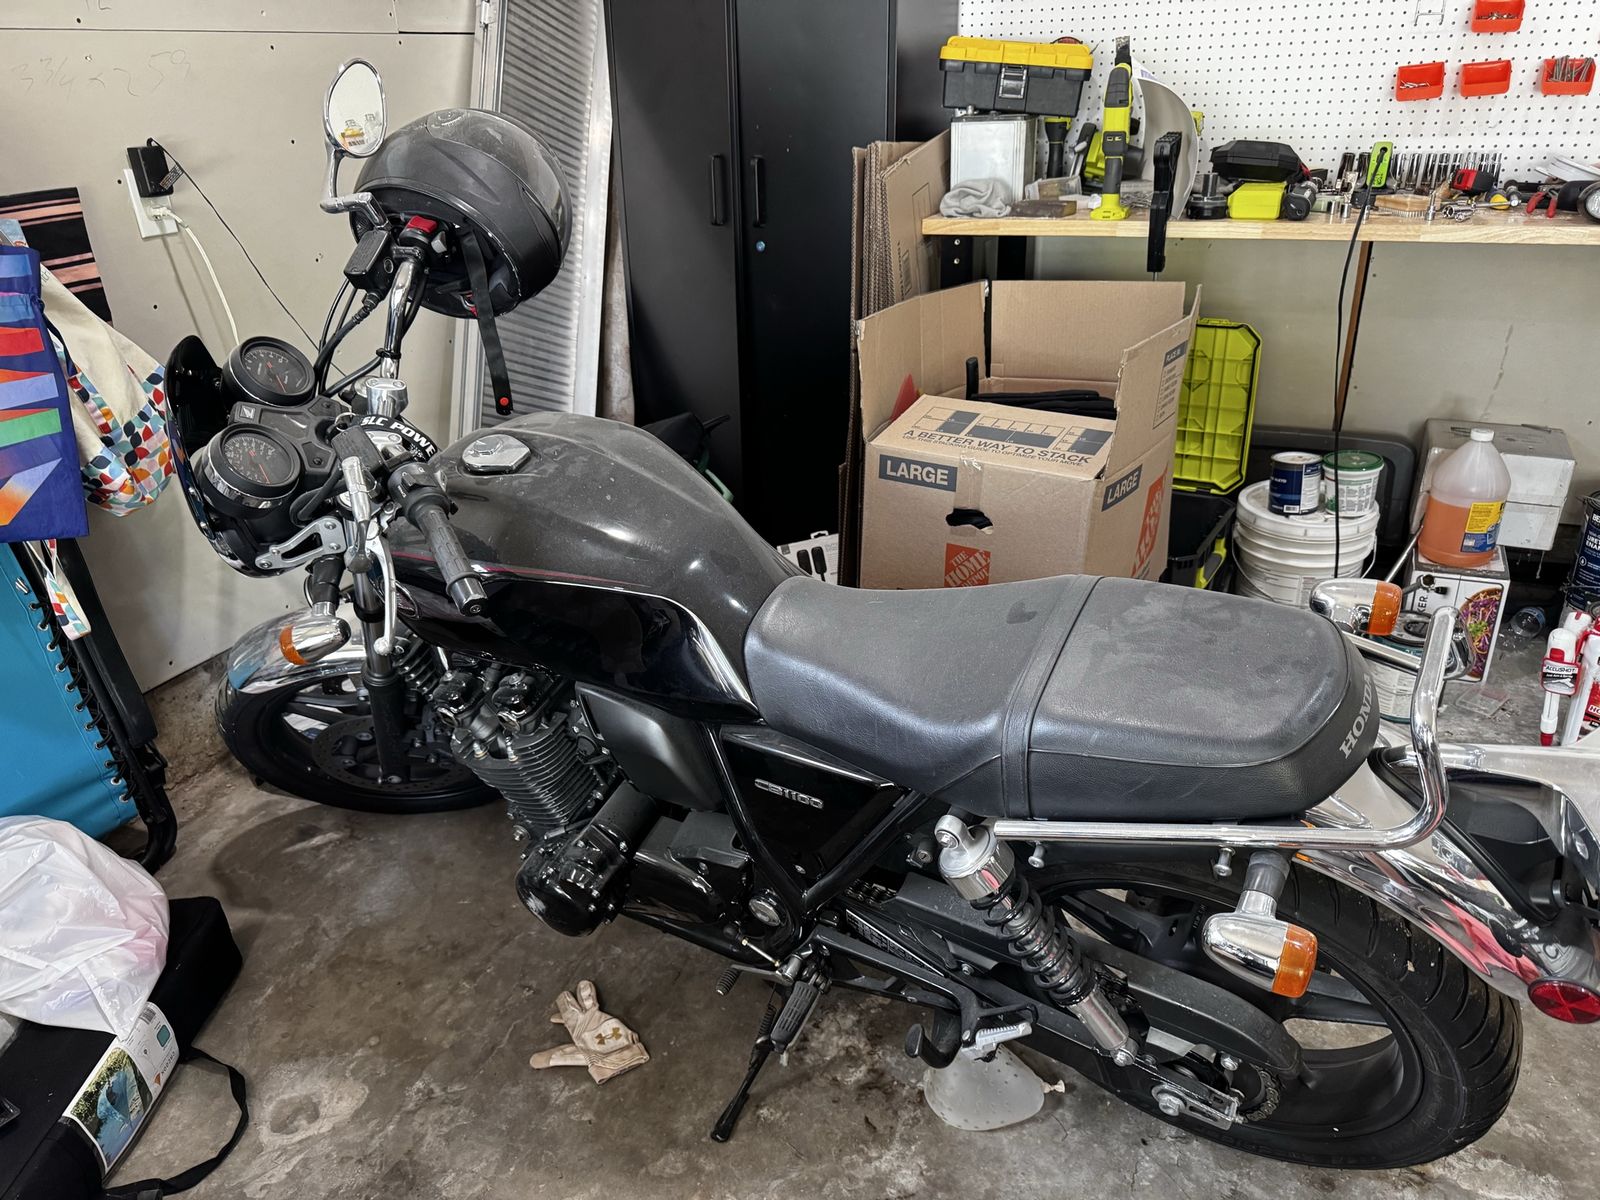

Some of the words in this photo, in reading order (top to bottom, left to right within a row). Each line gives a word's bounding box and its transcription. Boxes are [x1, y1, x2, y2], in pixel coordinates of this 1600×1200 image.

[361, 416, 388, 426] SLC
[389, 422, 436, 458] POWE
[918, 431, 974, 446] BETTER
[977, 440, 1010, 451] WAY
[1015, 446, 1035, 455] TO
[1038, 449, 1092, 464] STACK
[886, 459, 949, 486] LARGE
[1106, 470, 1139, 504] LARGE
[944, 550, 991, 586] HOME
[952, 550, 969, 567] THE
[754, 778, 823, 810] CB1100
